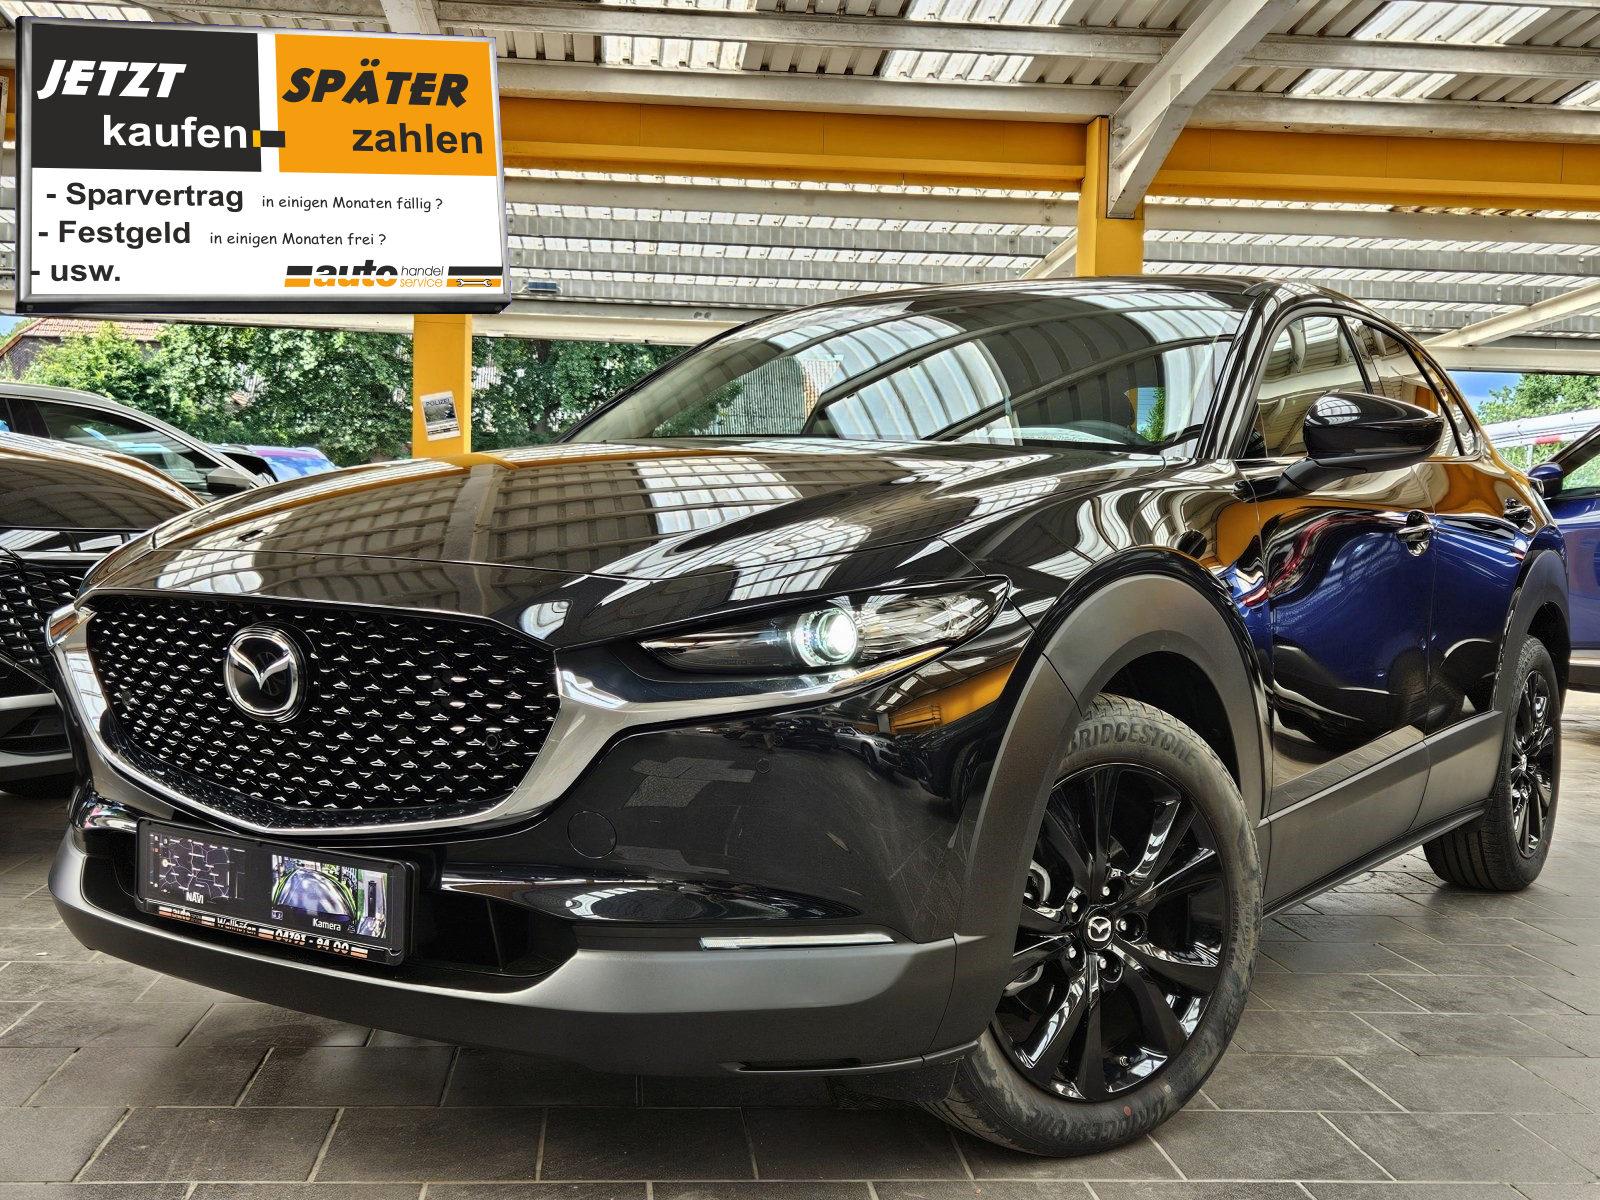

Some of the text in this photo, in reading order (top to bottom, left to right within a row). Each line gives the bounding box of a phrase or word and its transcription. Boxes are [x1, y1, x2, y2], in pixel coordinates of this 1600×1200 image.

[37, 59, 187, 100] JETZT
[282, 58, 469, 108] SPÄTER
[103, 115, 247, 149] kaufen
[352, 123, 483, 154] zahlen
[66, 182, 243, 213] Sparvertrag
[262, 195, 443, 213] in einigen Monaten fällig ?
[59, 220, 191, 249] Festgeld
[209, 232, 387, 248] in einigen Monaten frei ?
[51, 264, 121, 282] usw.
[313, 259, 399, 288] auto
[399, 277, 444, 288] service
[400, 265, 445, 277] handel
[185, 891, 205, 904] NAVI
[312, 917, 342, 932] Kamera
